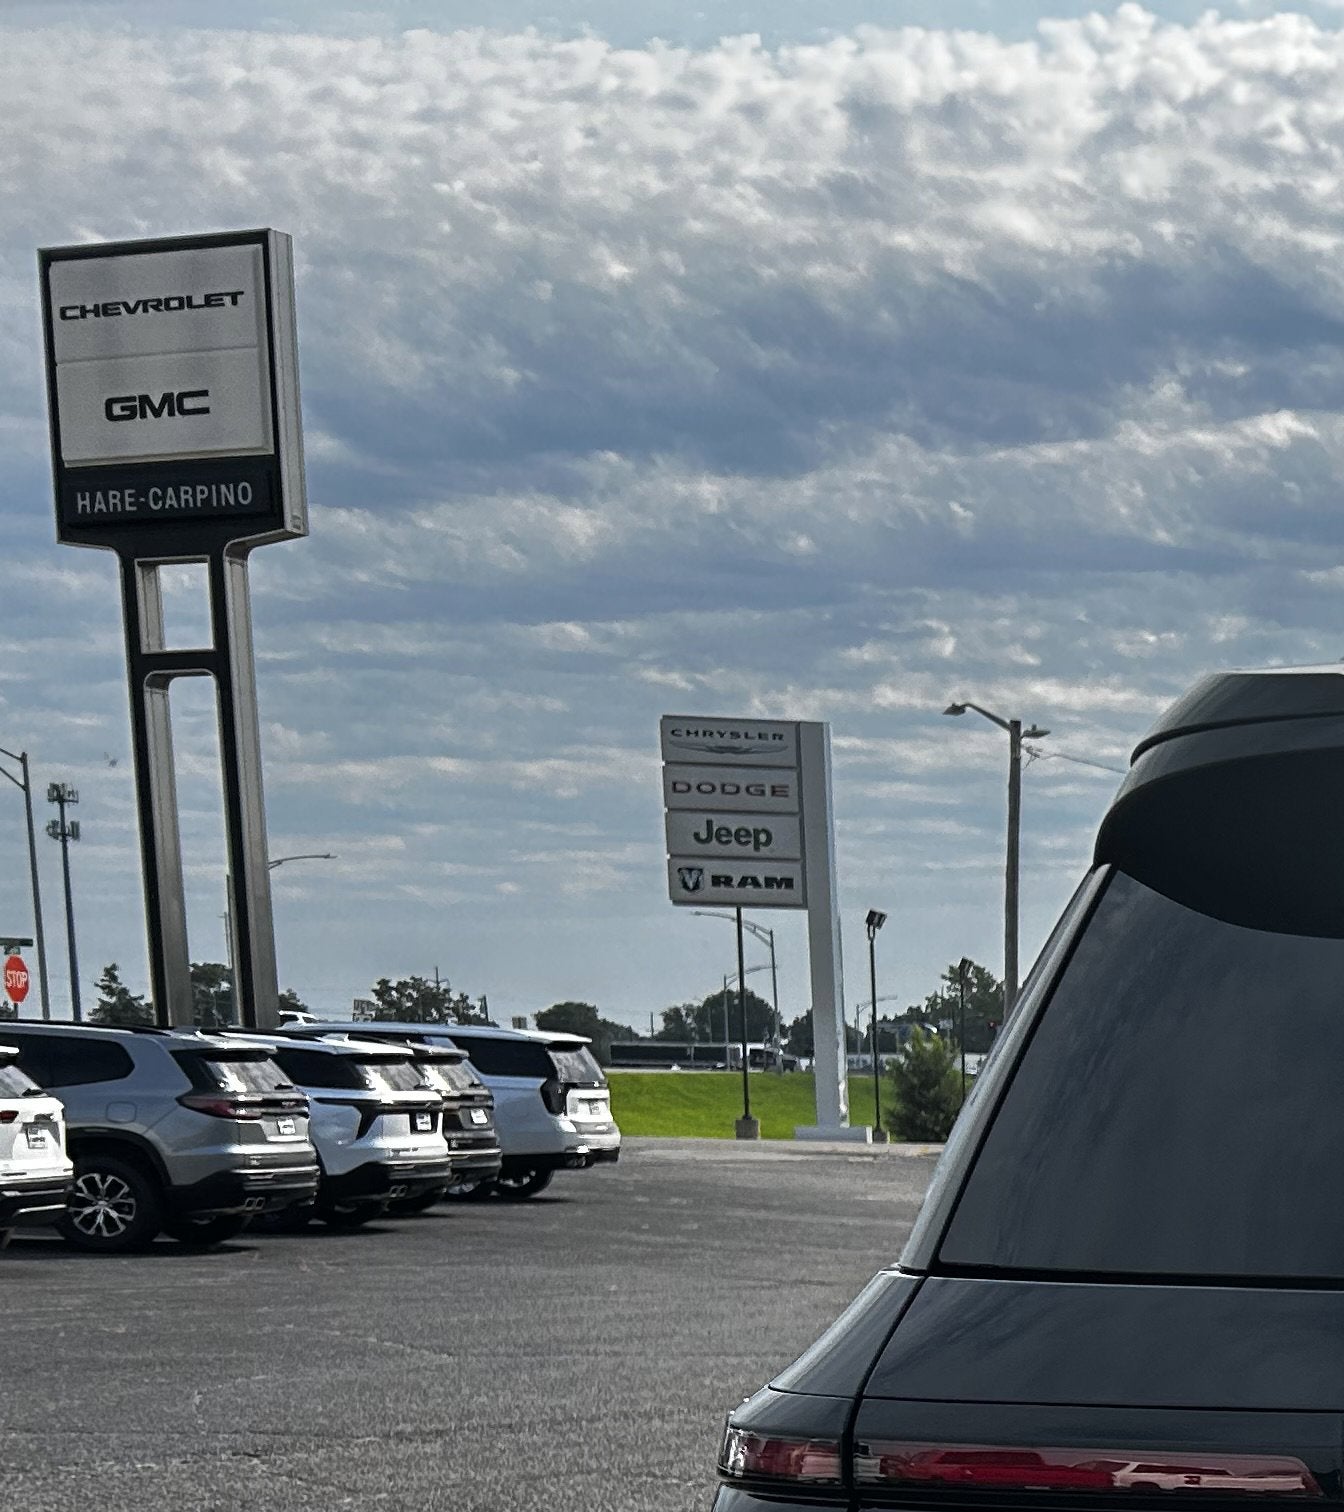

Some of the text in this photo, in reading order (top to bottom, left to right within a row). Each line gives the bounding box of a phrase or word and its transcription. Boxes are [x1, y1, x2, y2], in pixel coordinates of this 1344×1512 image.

[59, 291, 244, 320] CHEVROLET
[104, 389, 210, 422] GMC
[77, 482, 252, 514] HARE-CARPINO
[670, 729, 785, 742] CHRYSLER
[671, 780, 790, 798] DODGE
[693, 819, 773, 852] Jeep
[711, 874, 794, 890] RAM
[6, 970, 28, 989] STOP
